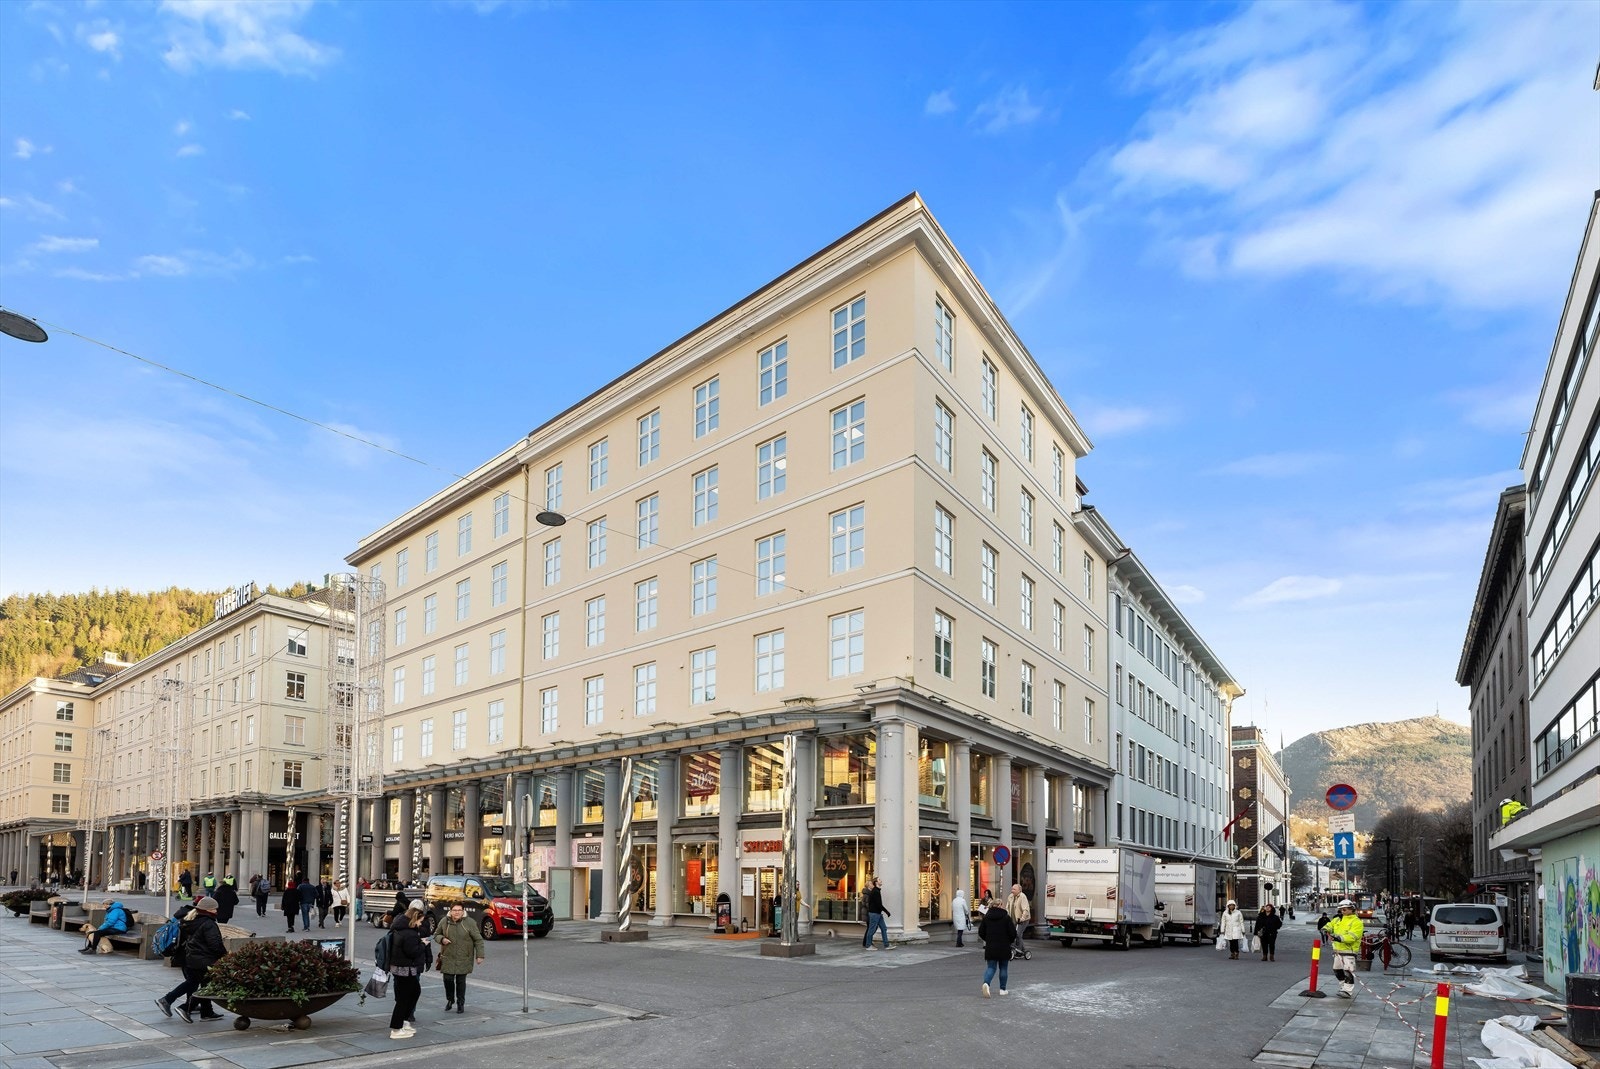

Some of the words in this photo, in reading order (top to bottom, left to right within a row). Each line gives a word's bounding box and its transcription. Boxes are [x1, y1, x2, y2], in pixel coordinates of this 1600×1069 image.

[215, 580, 254, 620] GALLERIET
[578, 845, 600, 854] BLOMZ
[825, 859, 847, 871] 25%
